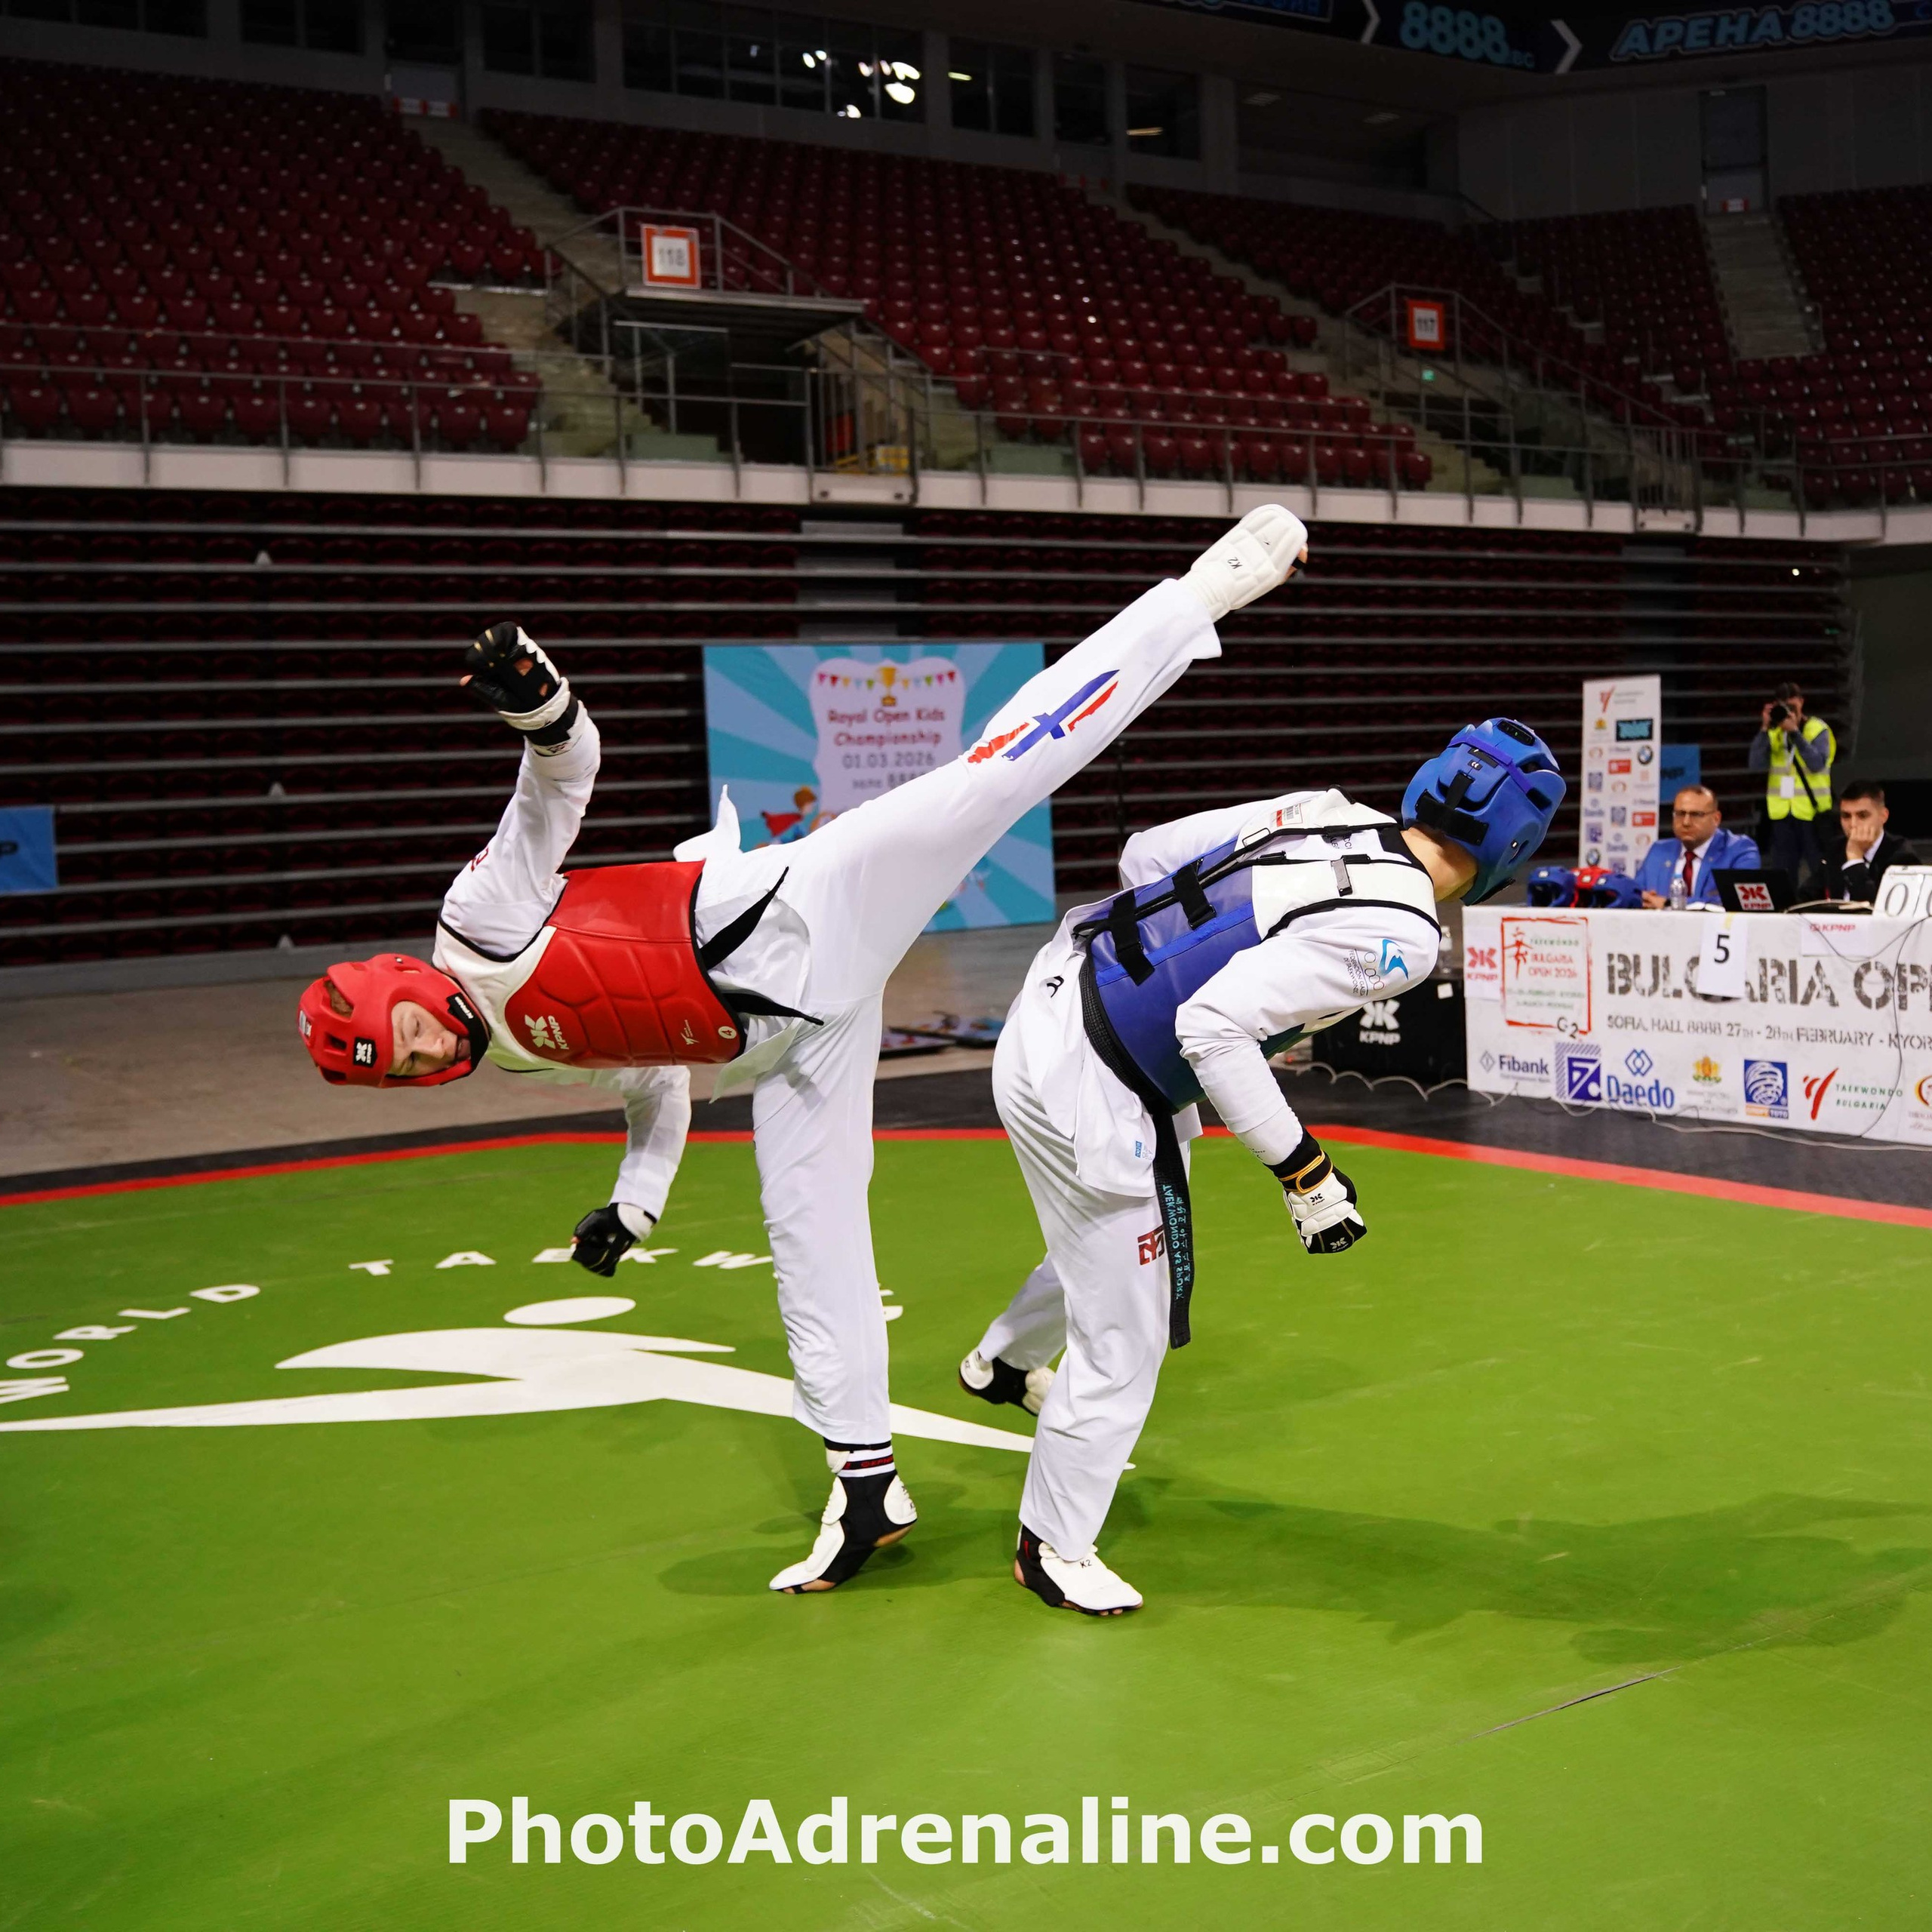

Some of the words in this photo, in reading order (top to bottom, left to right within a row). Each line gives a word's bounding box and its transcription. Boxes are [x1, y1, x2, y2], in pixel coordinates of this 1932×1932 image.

[828, 708, 867, 727] Royal
[873, 708, 910, 725] Open
[916, 708, 945, 721] Kids
[834, 730, 941, 749] Championship
[842, 751, 936, 768] 01.03.2026
[1714, 934, 1730, 963] 5
[1606, 952, 1839, 1008] BULRIA
[1854, 961, 1932, 1012] OP
[548, 1015, 570, 1050] KPNP
[1359, 1030, 1401, 1045] KPNP
[1796, 1027, 1874, 1047] FEBRUARY
[1499, 1054, 1549, 1075] Fibank
[1607, 1075, 1675, 1109] Daedo
[1835, 1084, 1903, 1097] TAEKWONDO
[1836, 1099, 1886, 1110] BULGARIA
[0, 1284, 261, 1404] WORLD
[1081, 1559, 1093, 1569] K2
